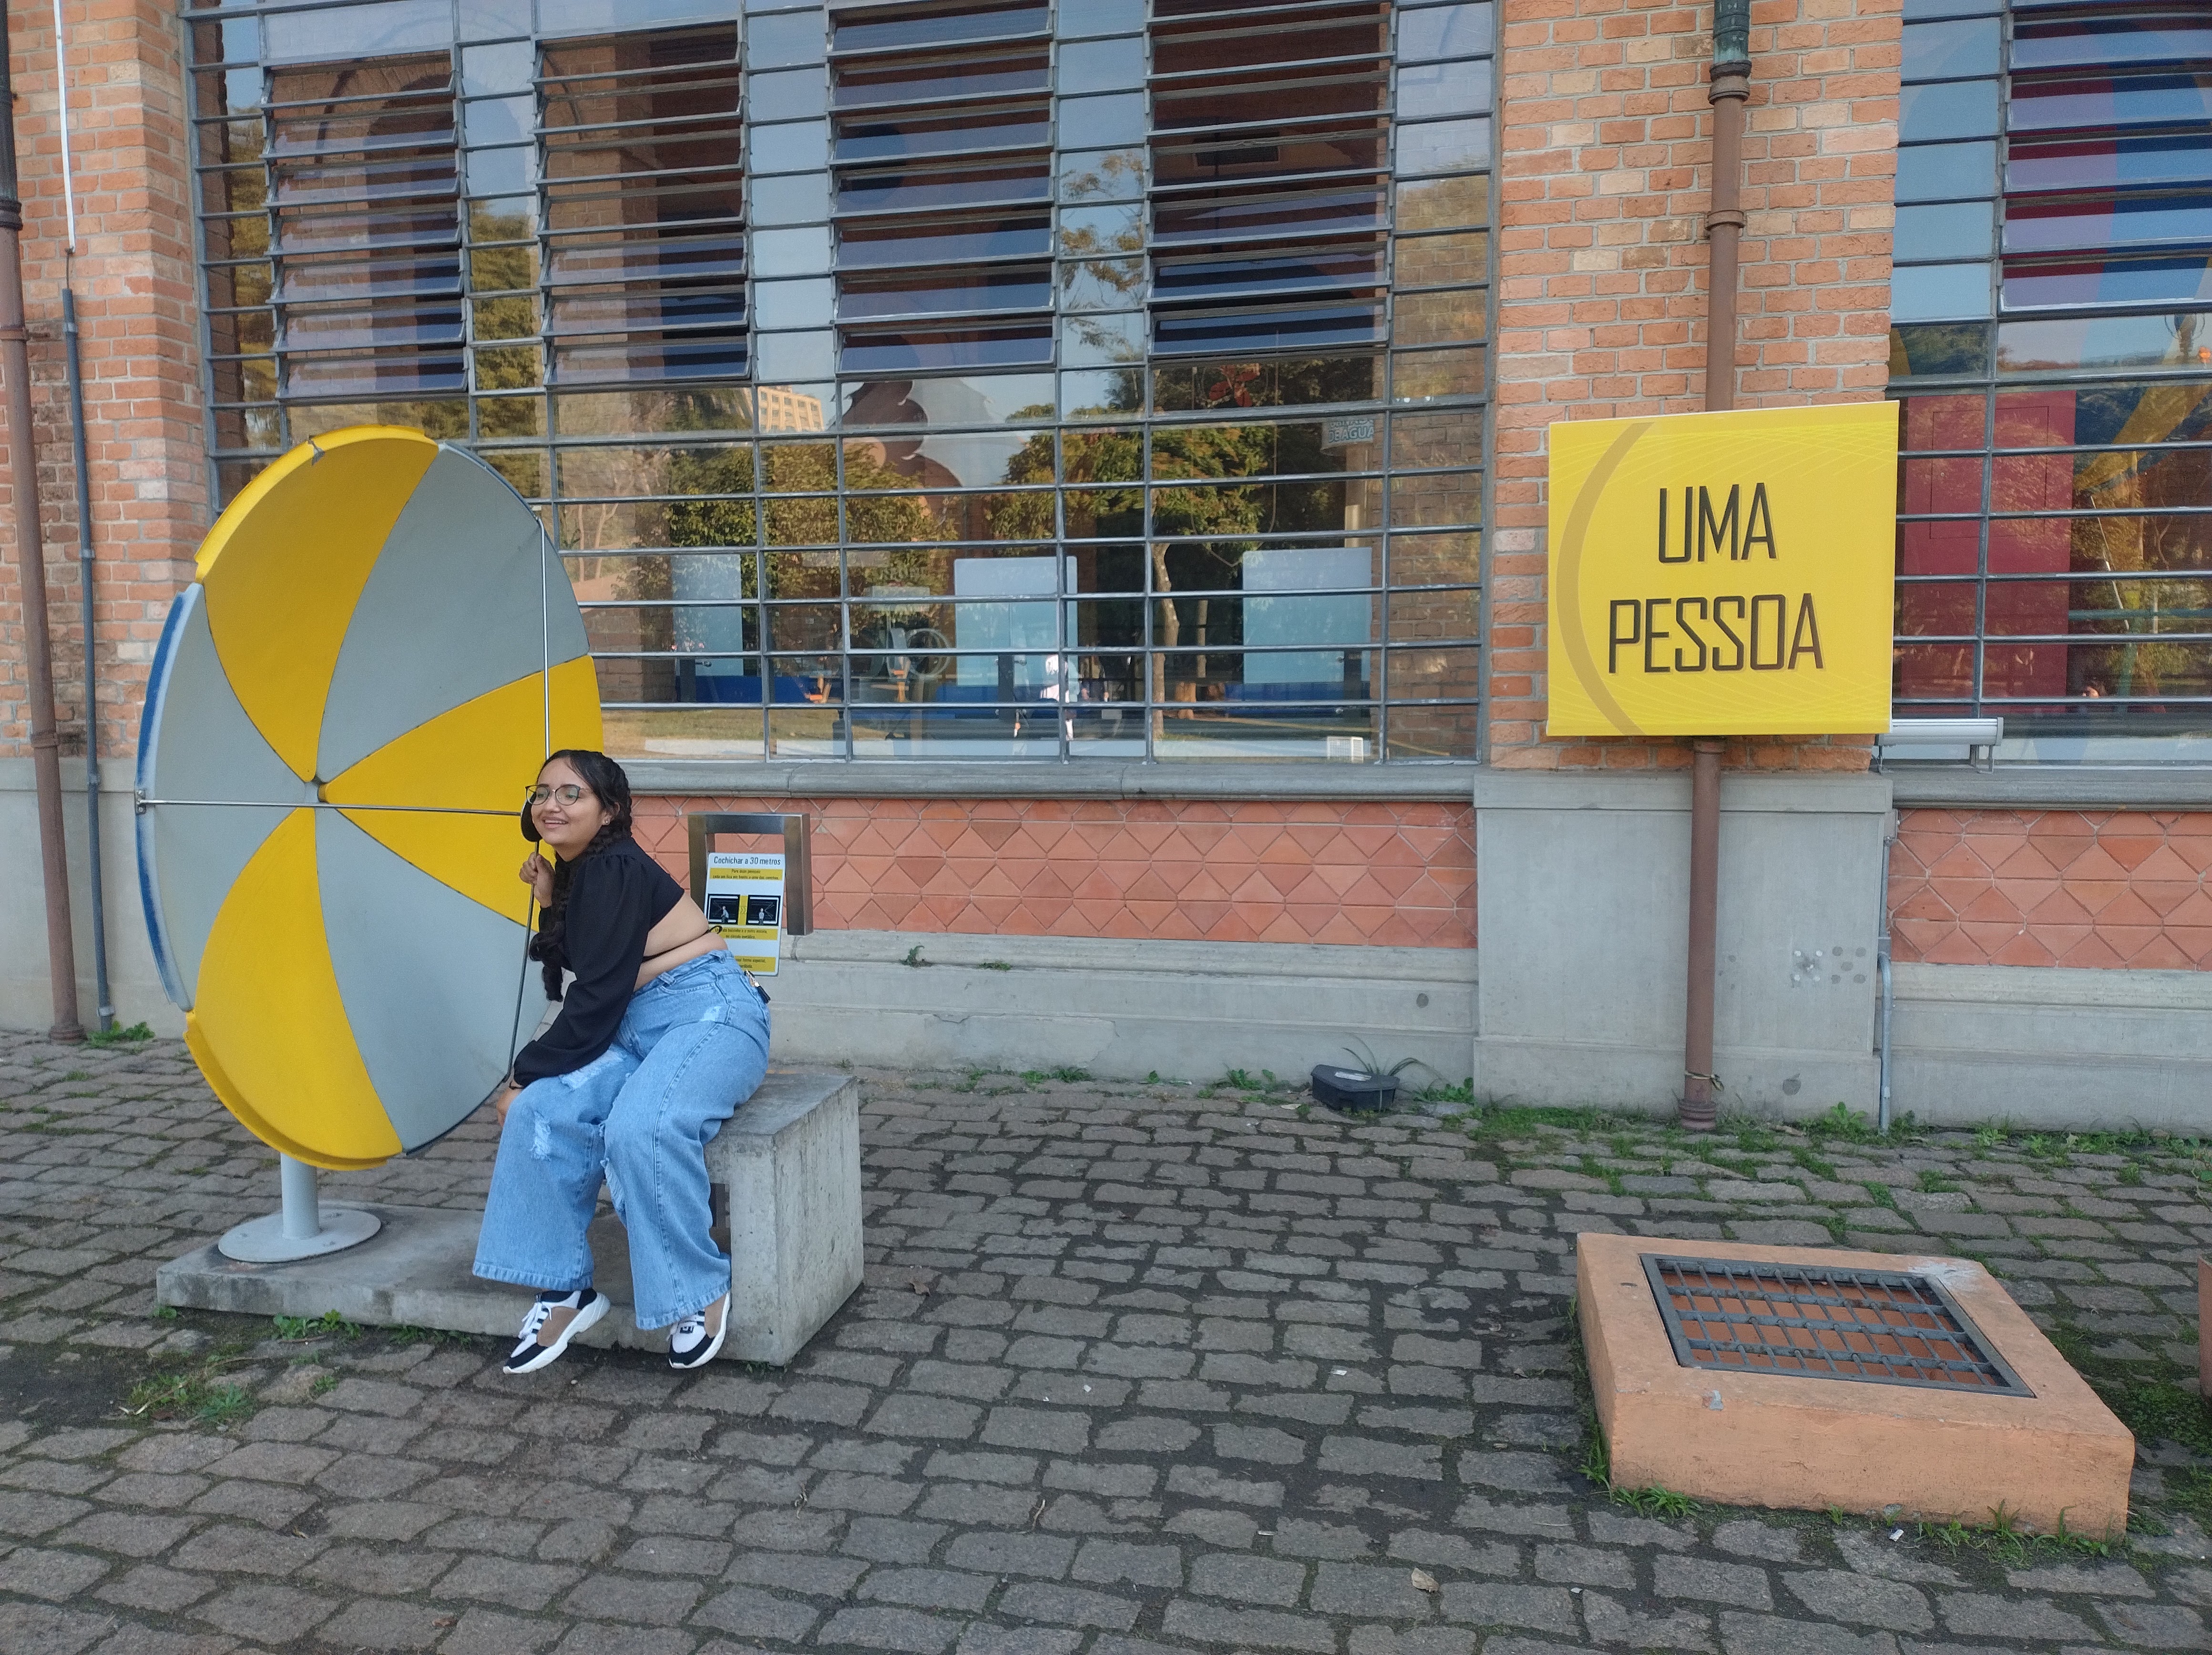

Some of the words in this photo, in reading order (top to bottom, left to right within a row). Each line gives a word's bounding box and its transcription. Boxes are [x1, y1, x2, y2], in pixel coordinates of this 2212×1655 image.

[1659, 482, 1777, 563] UMA
[1608, 593, 1824, 674] PESSOA
[714, 856, 743, 864] Cochichar
